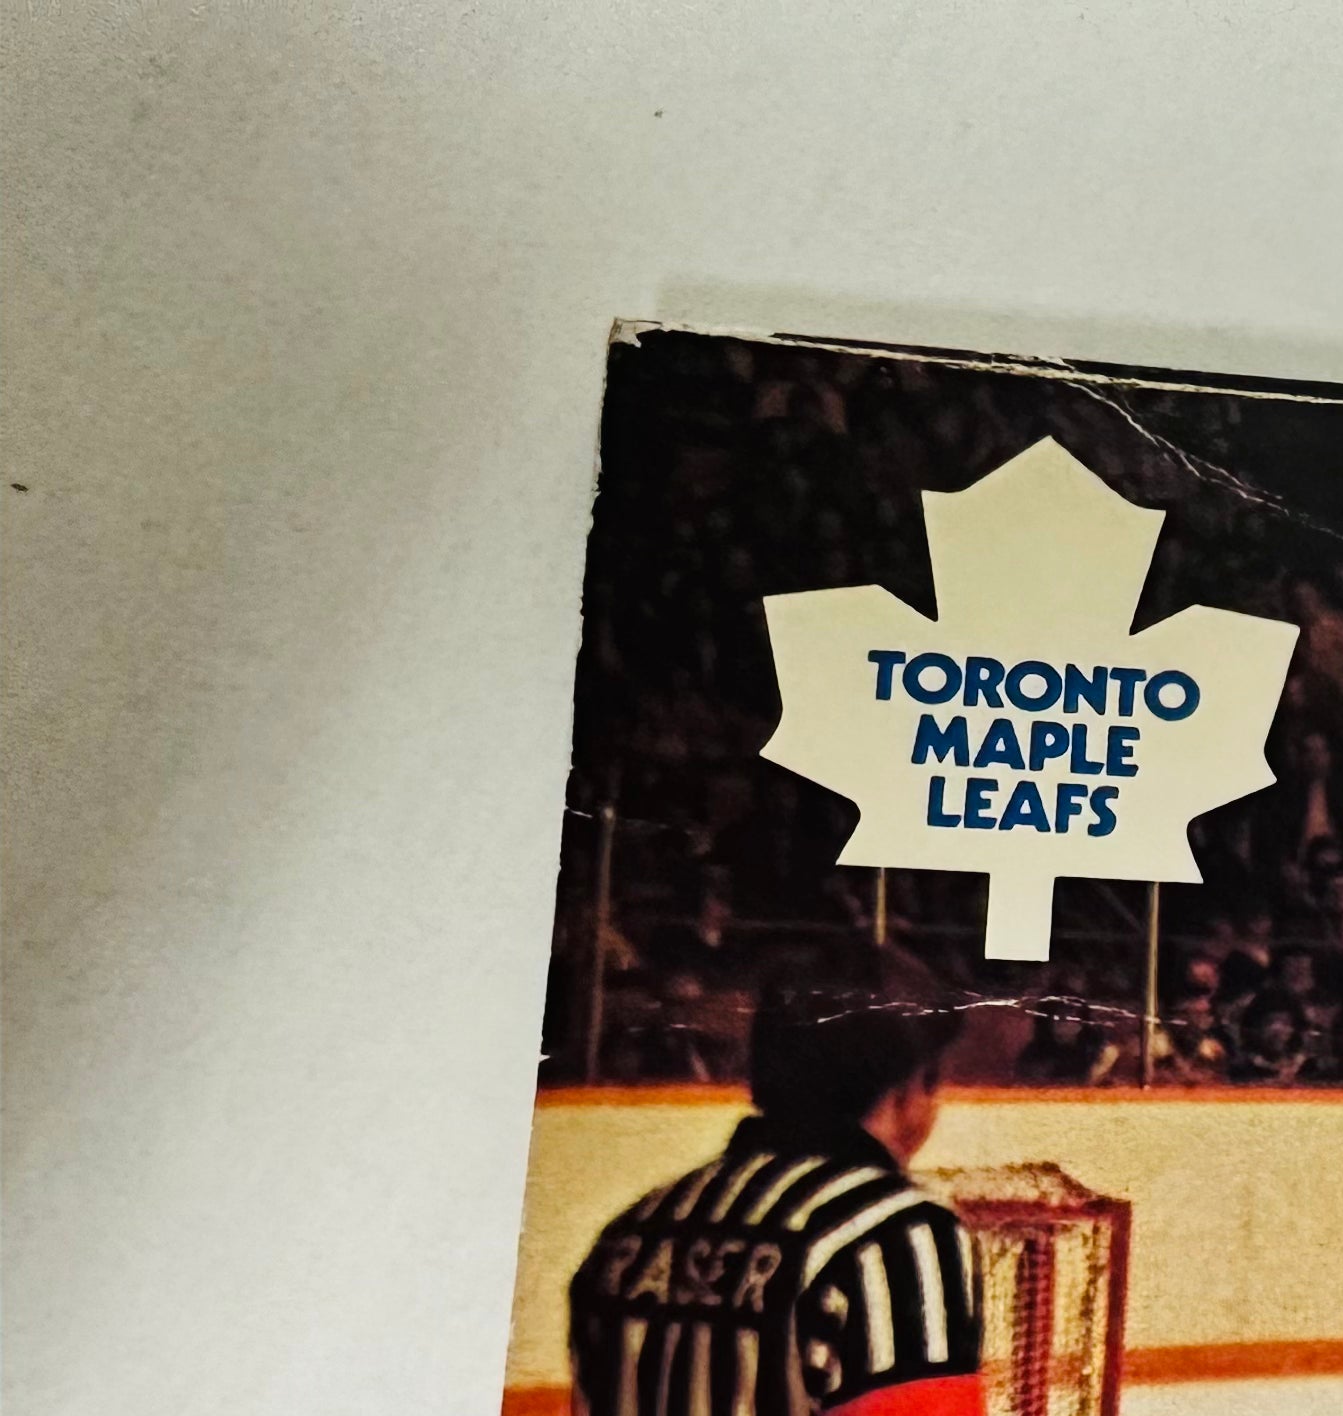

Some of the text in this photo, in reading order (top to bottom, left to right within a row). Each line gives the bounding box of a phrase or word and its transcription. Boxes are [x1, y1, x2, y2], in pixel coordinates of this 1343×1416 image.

[868, 650, 1201, 722] TORONTO
[911, 714, 1141, 778] MAPLE
[927, 776, 1120, 838] LEAFS
